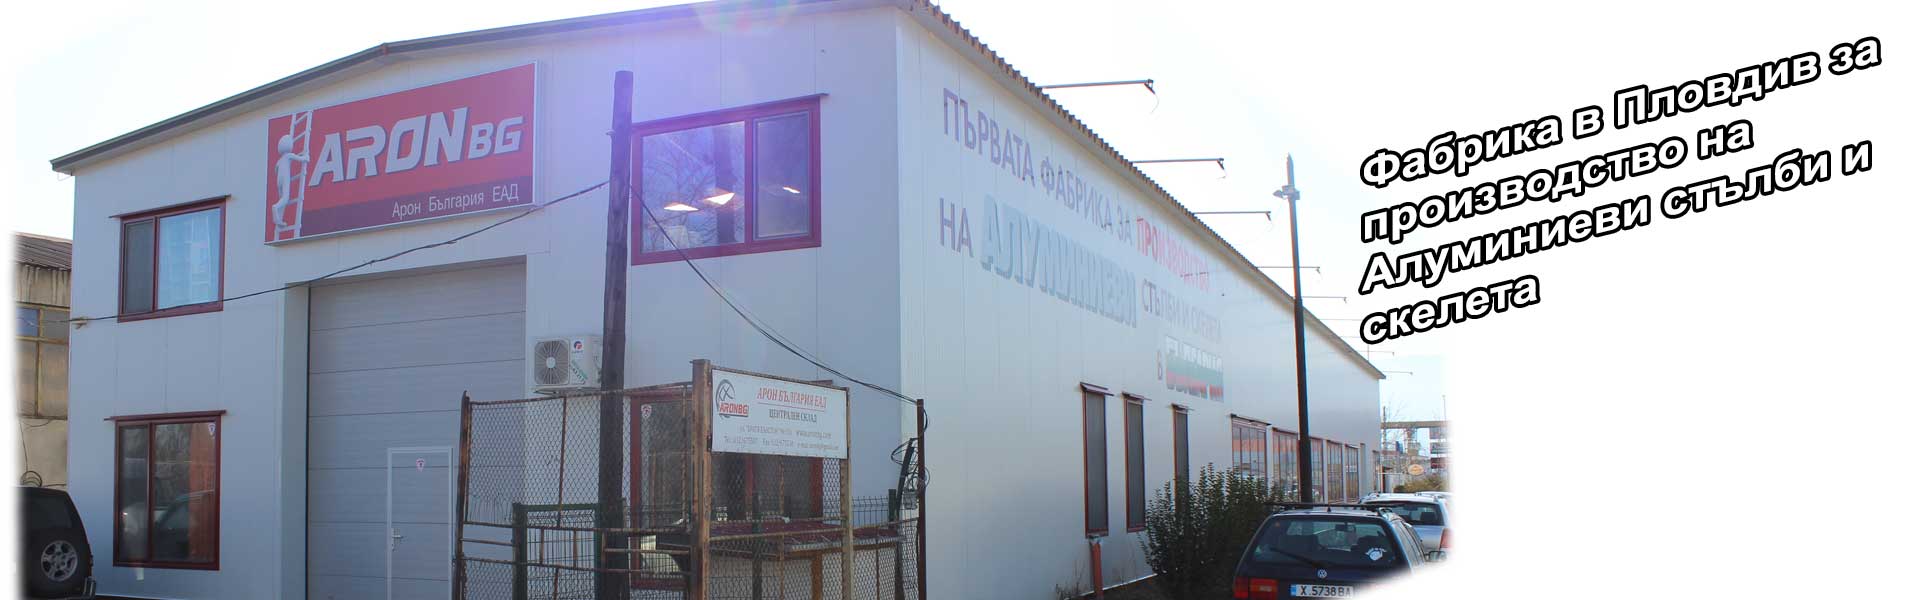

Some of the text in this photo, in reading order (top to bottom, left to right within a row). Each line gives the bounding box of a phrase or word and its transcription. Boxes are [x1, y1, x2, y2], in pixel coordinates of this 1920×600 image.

[943, 87, 1035, 188] ПЪРВАТА
[1040, 155, 1113, 234] ФАБРИКА
[1117, 205, 1134, 247] ЗА
[391, 183, 519, 219] Арон България ЕАД
[939, 197, 974, 258] НА
[757, 387, 777, 401] АРОН
[779, 390, 814, 406] БЪЛГАРИЯ
